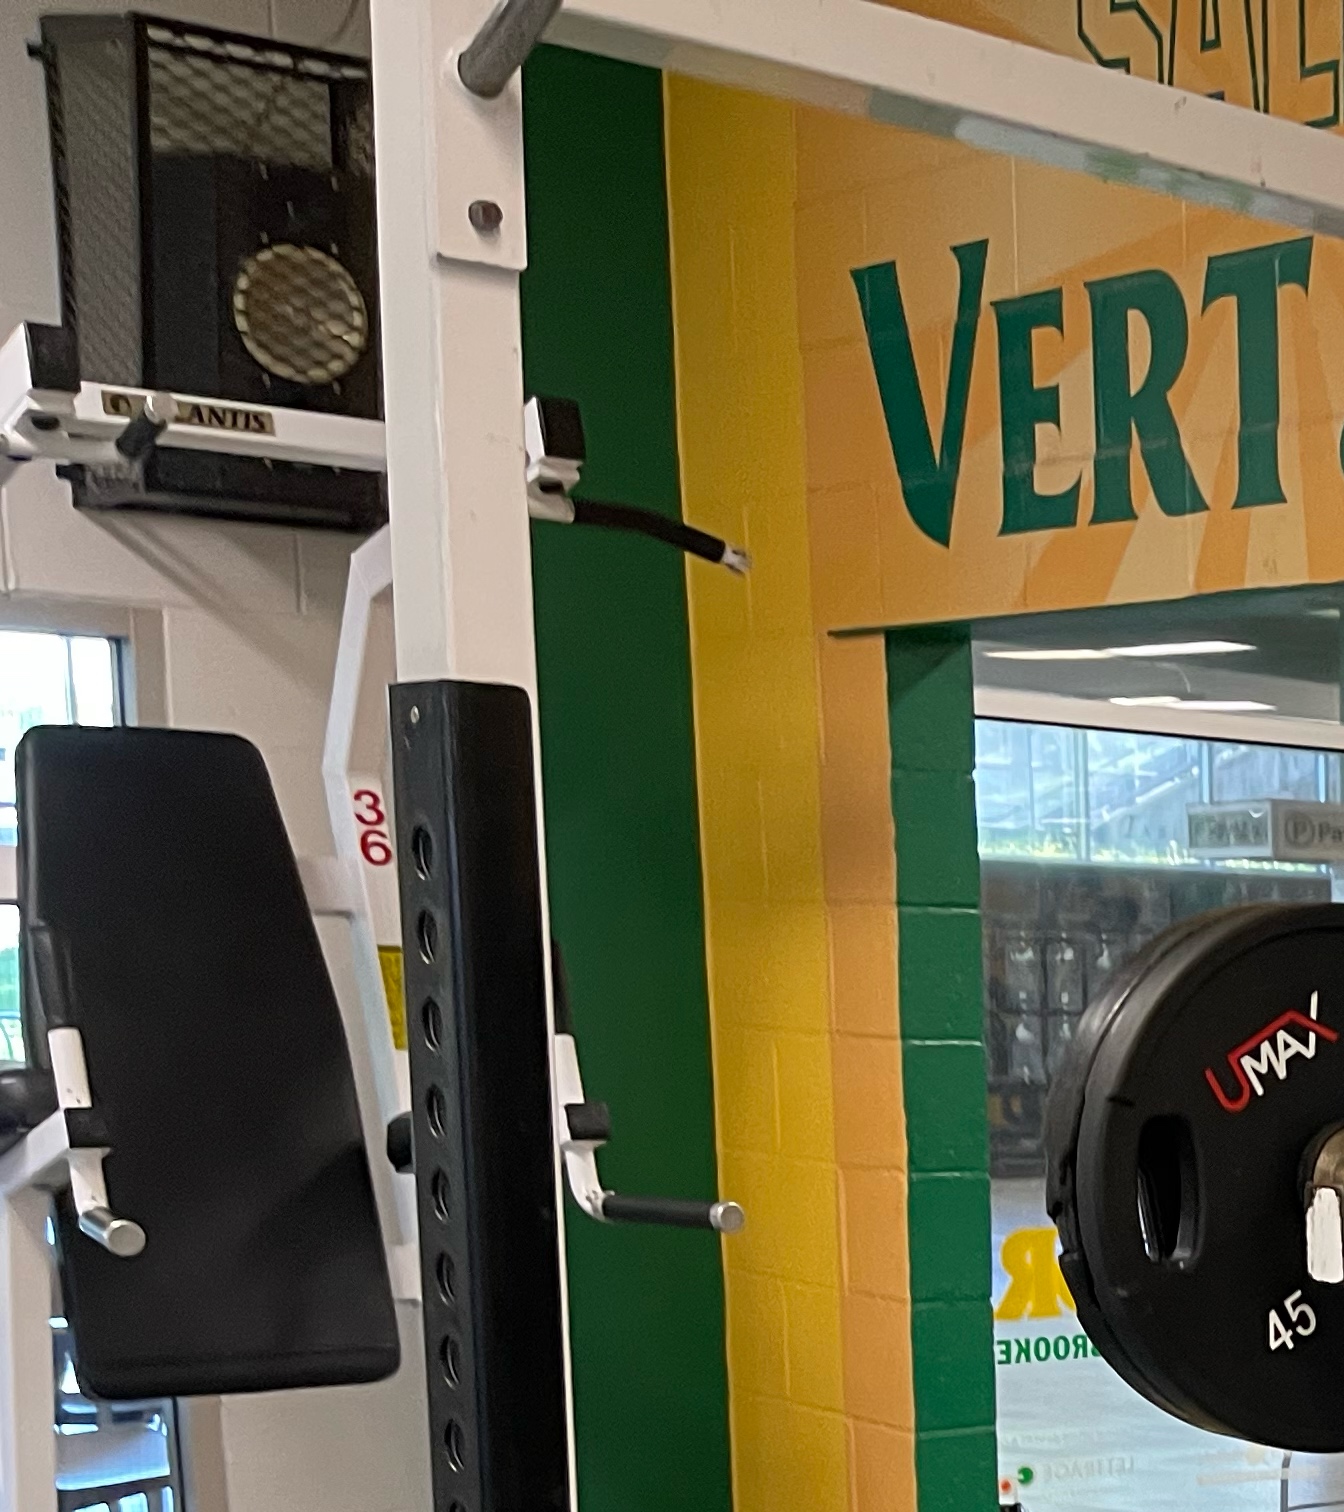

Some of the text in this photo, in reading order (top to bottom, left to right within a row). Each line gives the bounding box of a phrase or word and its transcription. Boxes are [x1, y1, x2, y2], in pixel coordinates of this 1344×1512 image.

[850, 236, 1315, 550] VERT
[1204, 989, 1340, 1113] UMAX
[1267, 1289, 1317, 1351] 45
